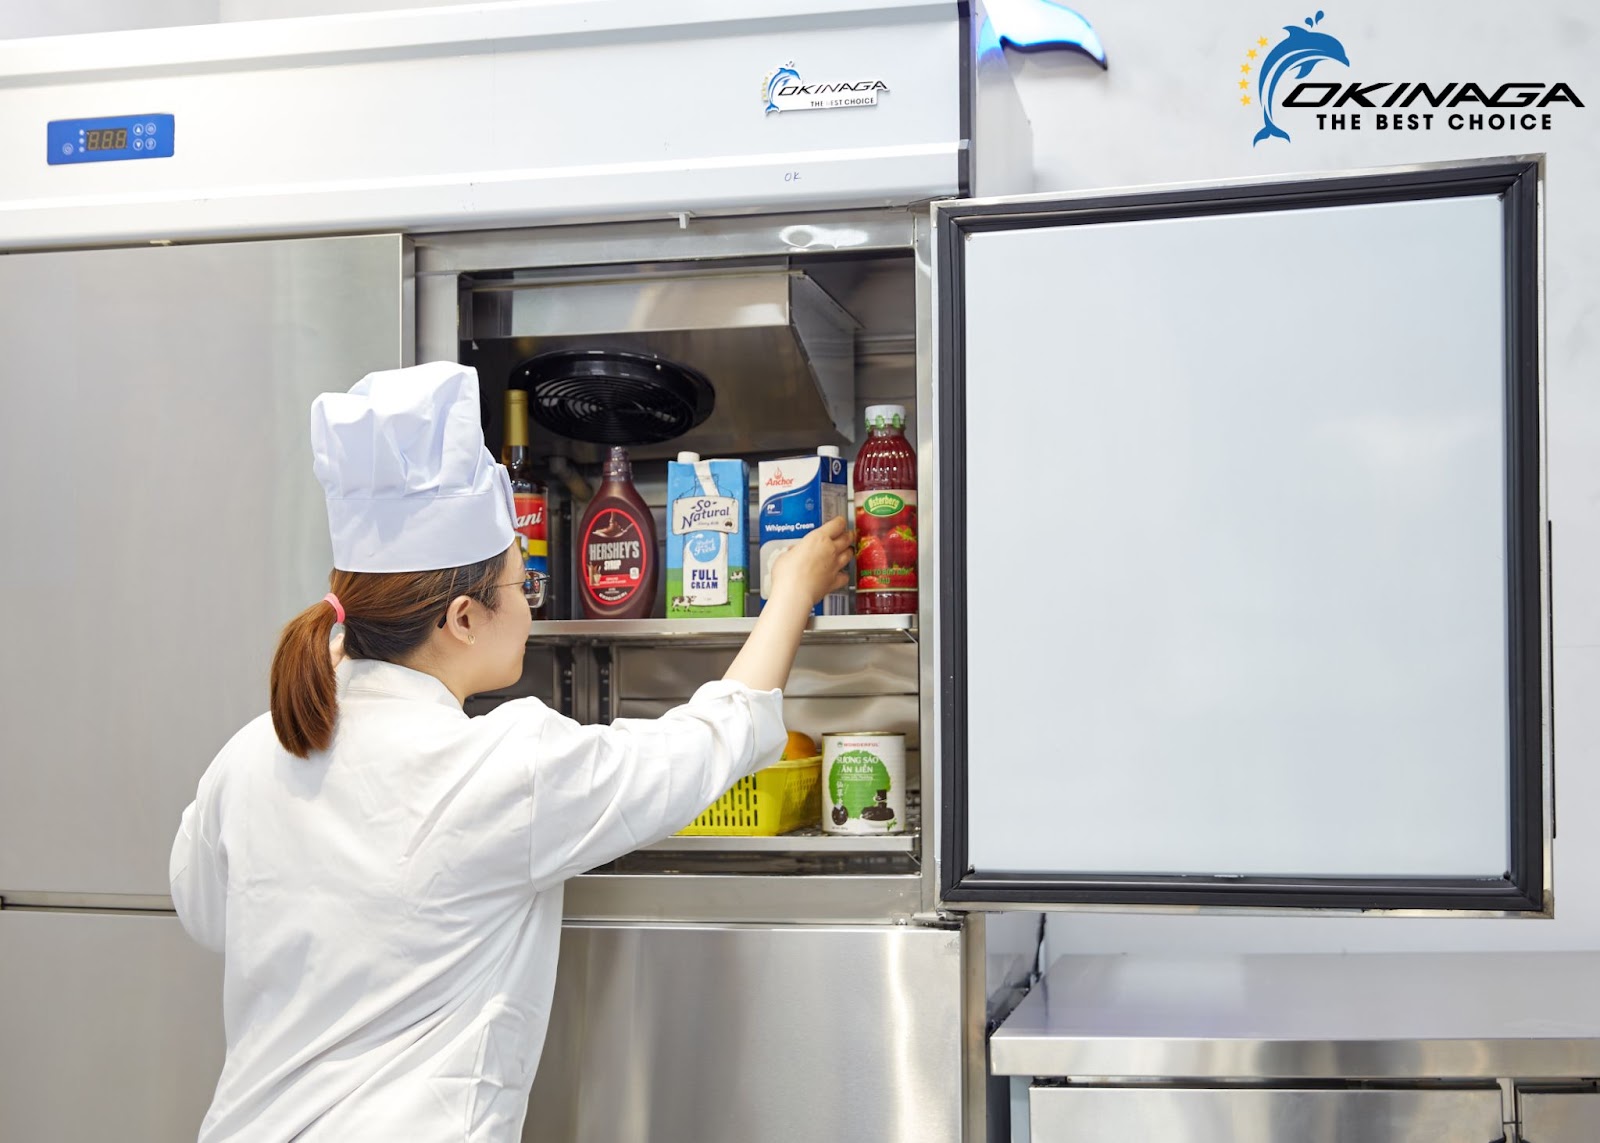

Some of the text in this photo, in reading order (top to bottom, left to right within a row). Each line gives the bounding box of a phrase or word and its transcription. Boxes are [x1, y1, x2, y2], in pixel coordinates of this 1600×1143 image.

[778, 81, 888, 96] OKINAGA
[810, 97, 874, 108] THE EST CHOICE
[784, 171, 801, 182] OK
[765, 477, 794, 487] Anchor
[517, 507, 542, 527] ani
[681, 506, 730, 529] Natural
[765, 522, 815, 533] Whipping Cream
[589, 540, 640, 561] HERSHEY'S
[691, 569, 719, 581] FULL
[690, 581, 719, 589] CREAM
